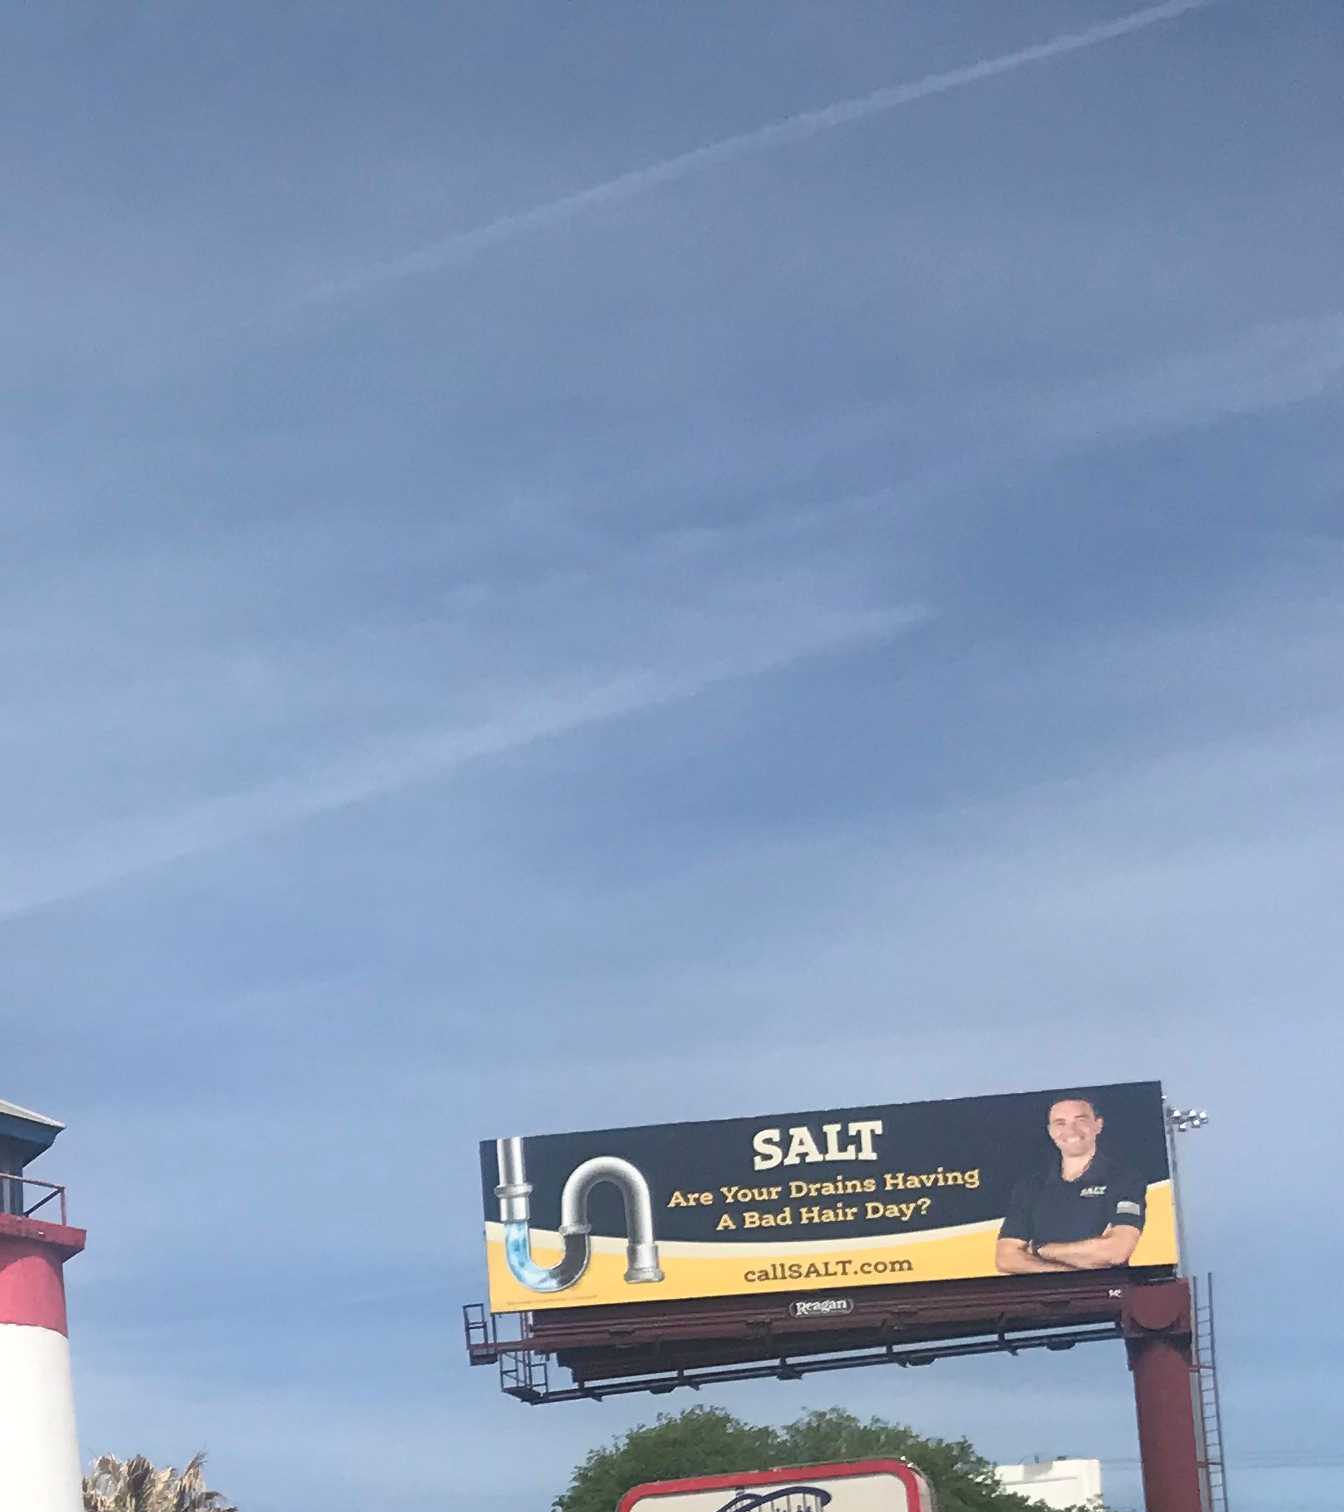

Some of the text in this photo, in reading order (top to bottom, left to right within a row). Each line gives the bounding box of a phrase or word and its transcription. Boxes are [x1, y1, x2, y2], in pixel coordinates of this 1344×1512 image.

[753, 1120, 883, 1171] SALT
[667, 1167, 980, 1208] Are Your Drains Having
[716, 1198, 932, 1231] A Bad Hair Day?
[743, 1258, 914, 1283] callSALT.com
[796, 1299, 848, 1316] Reagan
